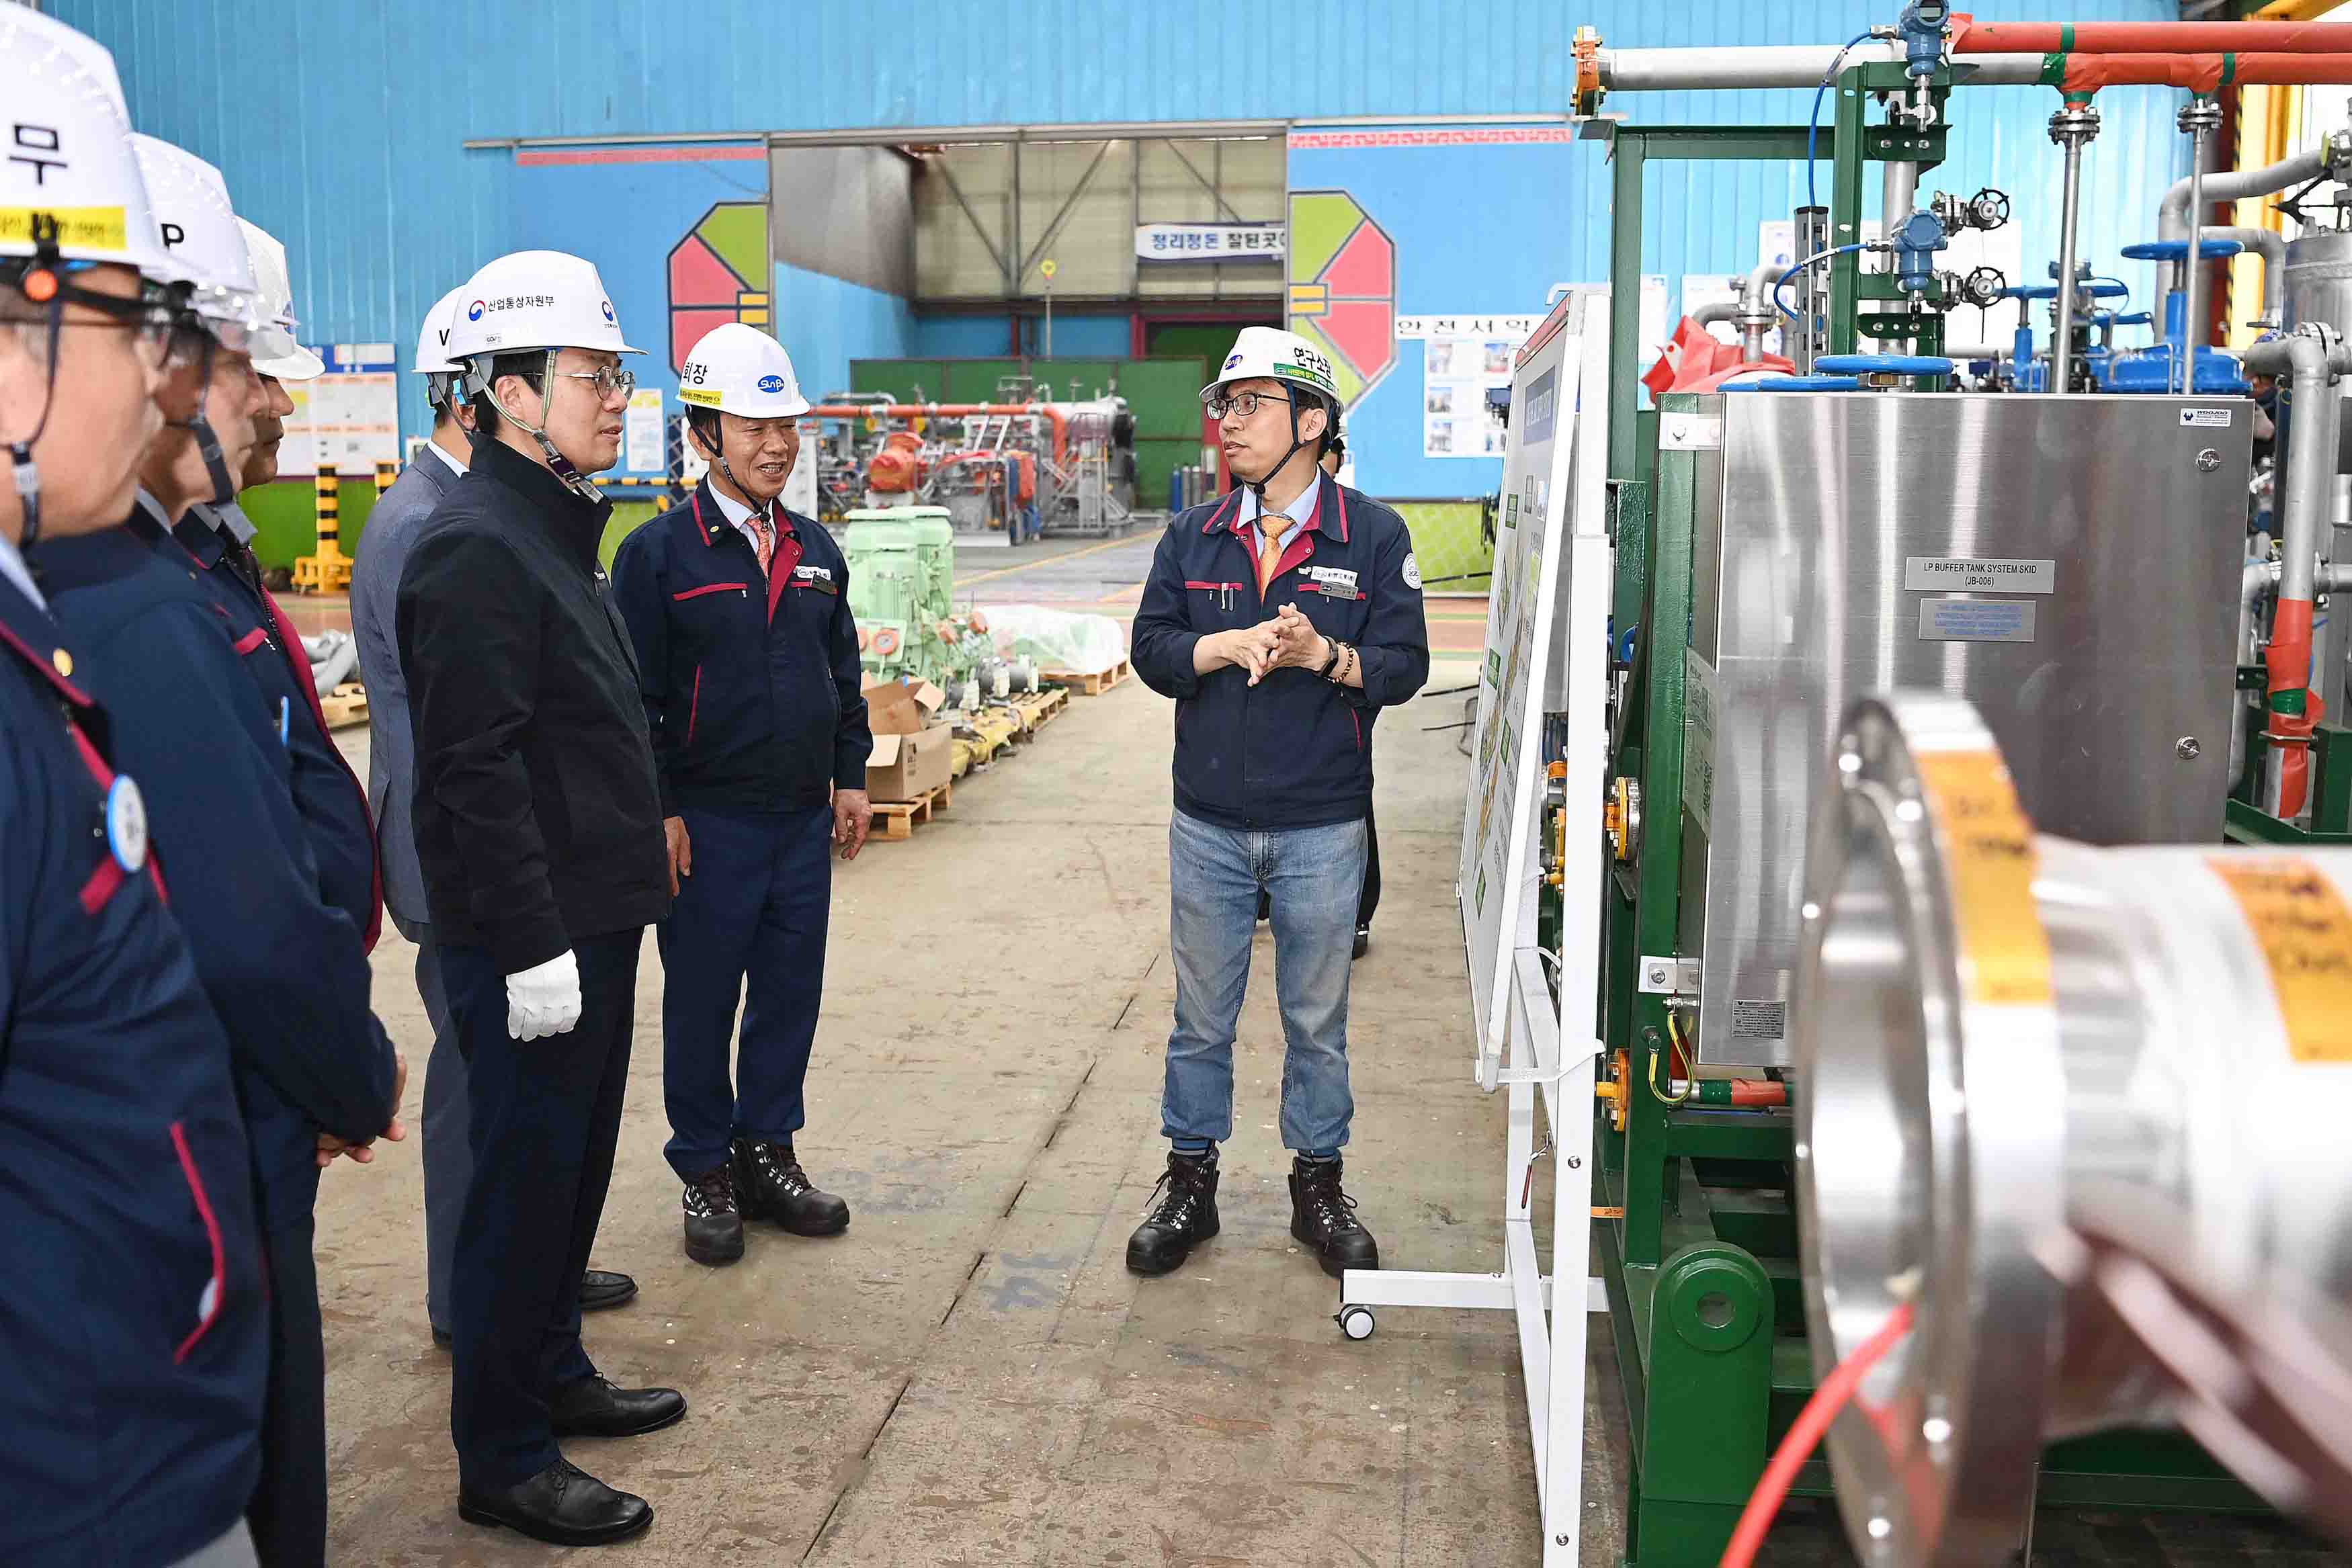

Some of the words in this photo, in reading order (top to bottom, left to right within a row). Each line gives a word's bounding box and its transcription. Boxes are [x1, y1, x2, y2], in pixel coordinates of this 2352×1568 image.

[9, 123, 68, 186] 무
[1152, 232, 1218, 250] 정리정돈
[1227, 232, 1285, 249] 잘된곳
[488, 295, 554, 312] 산업통상자원부
[439, 328, 450, 346] V
[1294, 347, 1332, 379] 연구소장
[683, 362, 708, 385] 회장
[1924, 563, 1933, 571] LP
[1935, 563, 1964, 572] BUFFER
[1966, 564, 1985, 573] TANK
[1987, 564, 2017, 574] SYSTEM
[2019, 565, 2037, 574] SKID
[1965, 576, 1994, 587] (JB-006)
